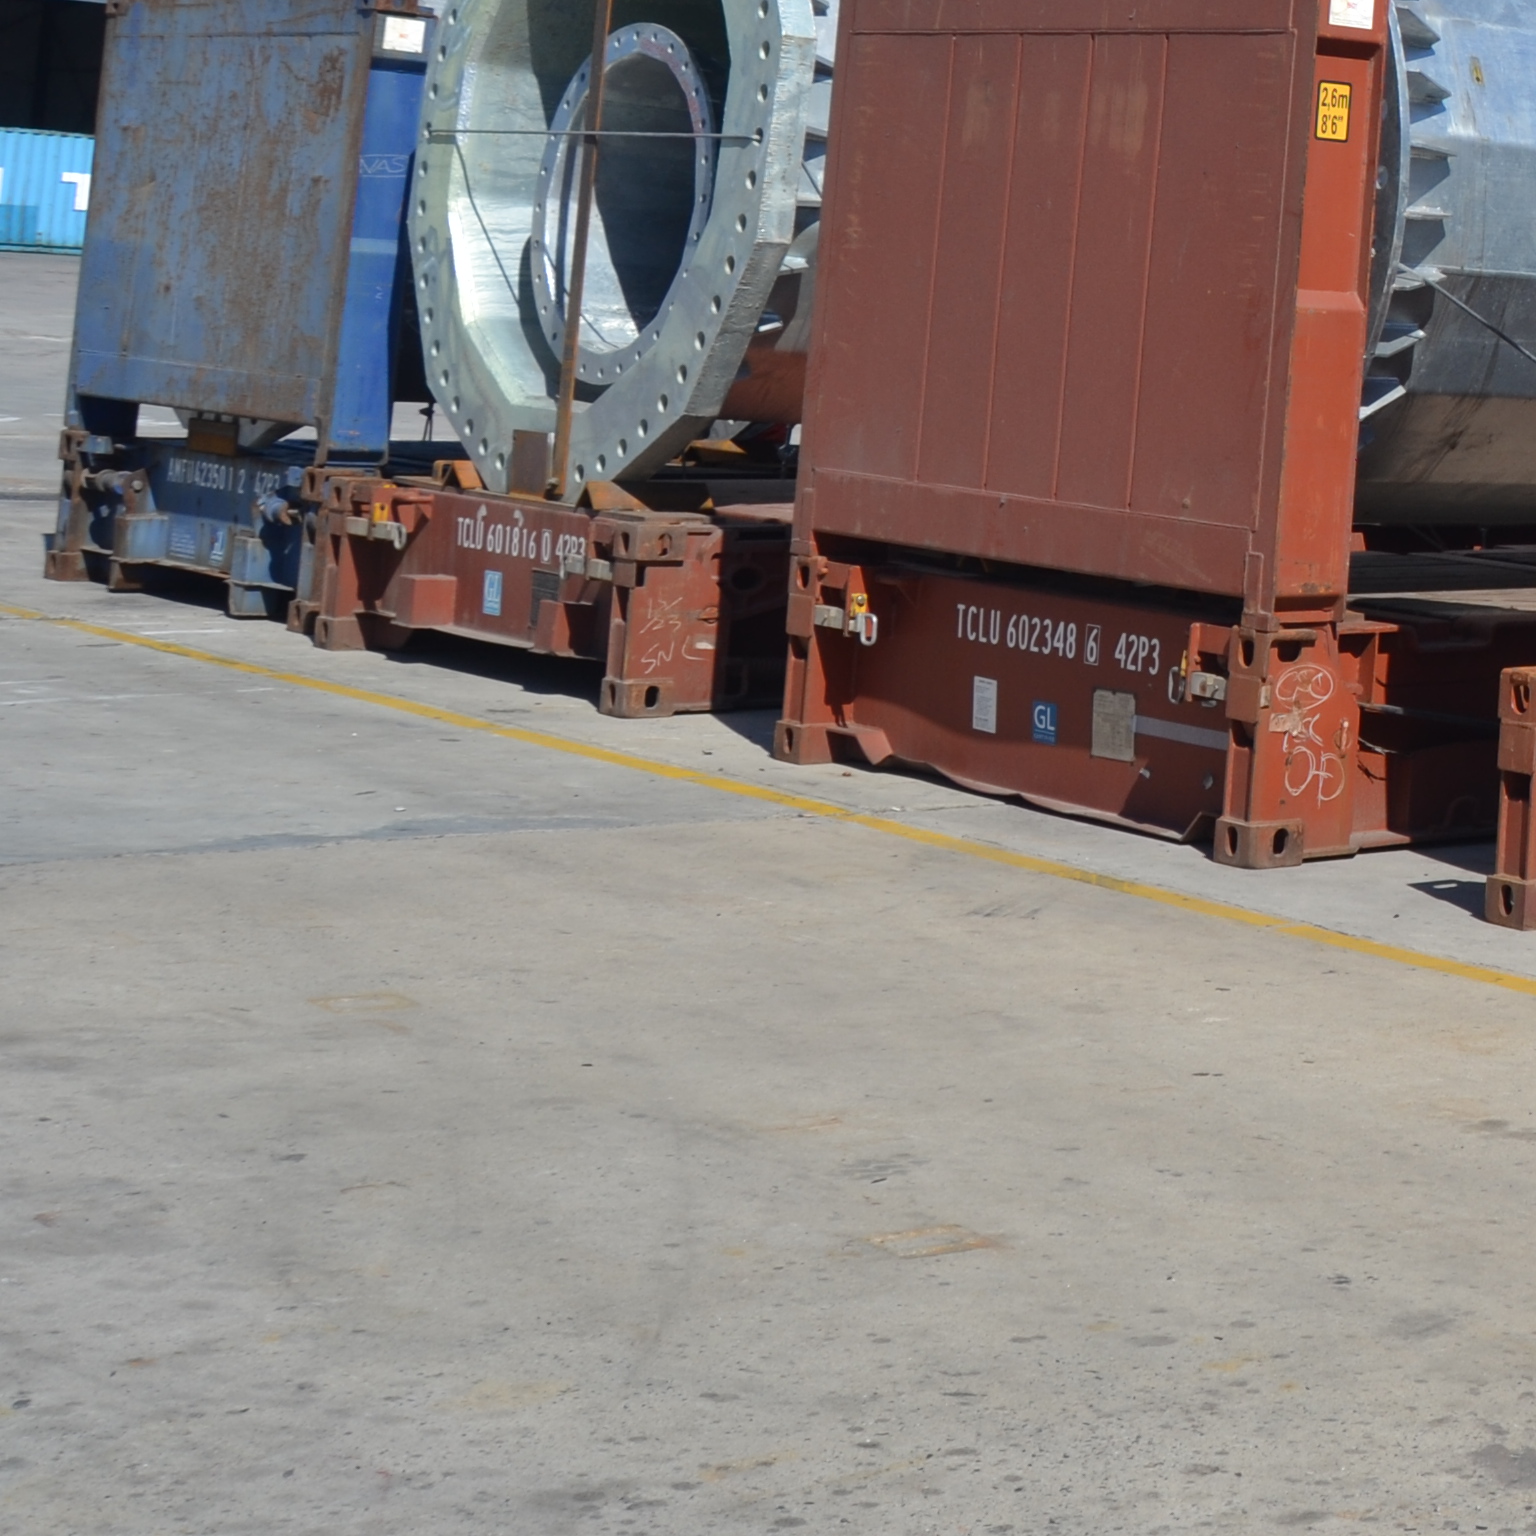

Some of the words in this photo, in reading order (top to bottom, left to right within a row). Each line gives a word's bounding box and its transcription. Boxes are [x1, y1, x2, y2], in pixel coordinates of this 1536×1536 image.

[486, 523, 537, 560] 601816
[957, 604, 1001, 645] TCLU
[1006, 614, 1077, 659] 602348
[1087, 628, 1098, 662] 6
[1114, 632, 1160, 675] 42P3
[1034, 705, 1056, 731] GL
